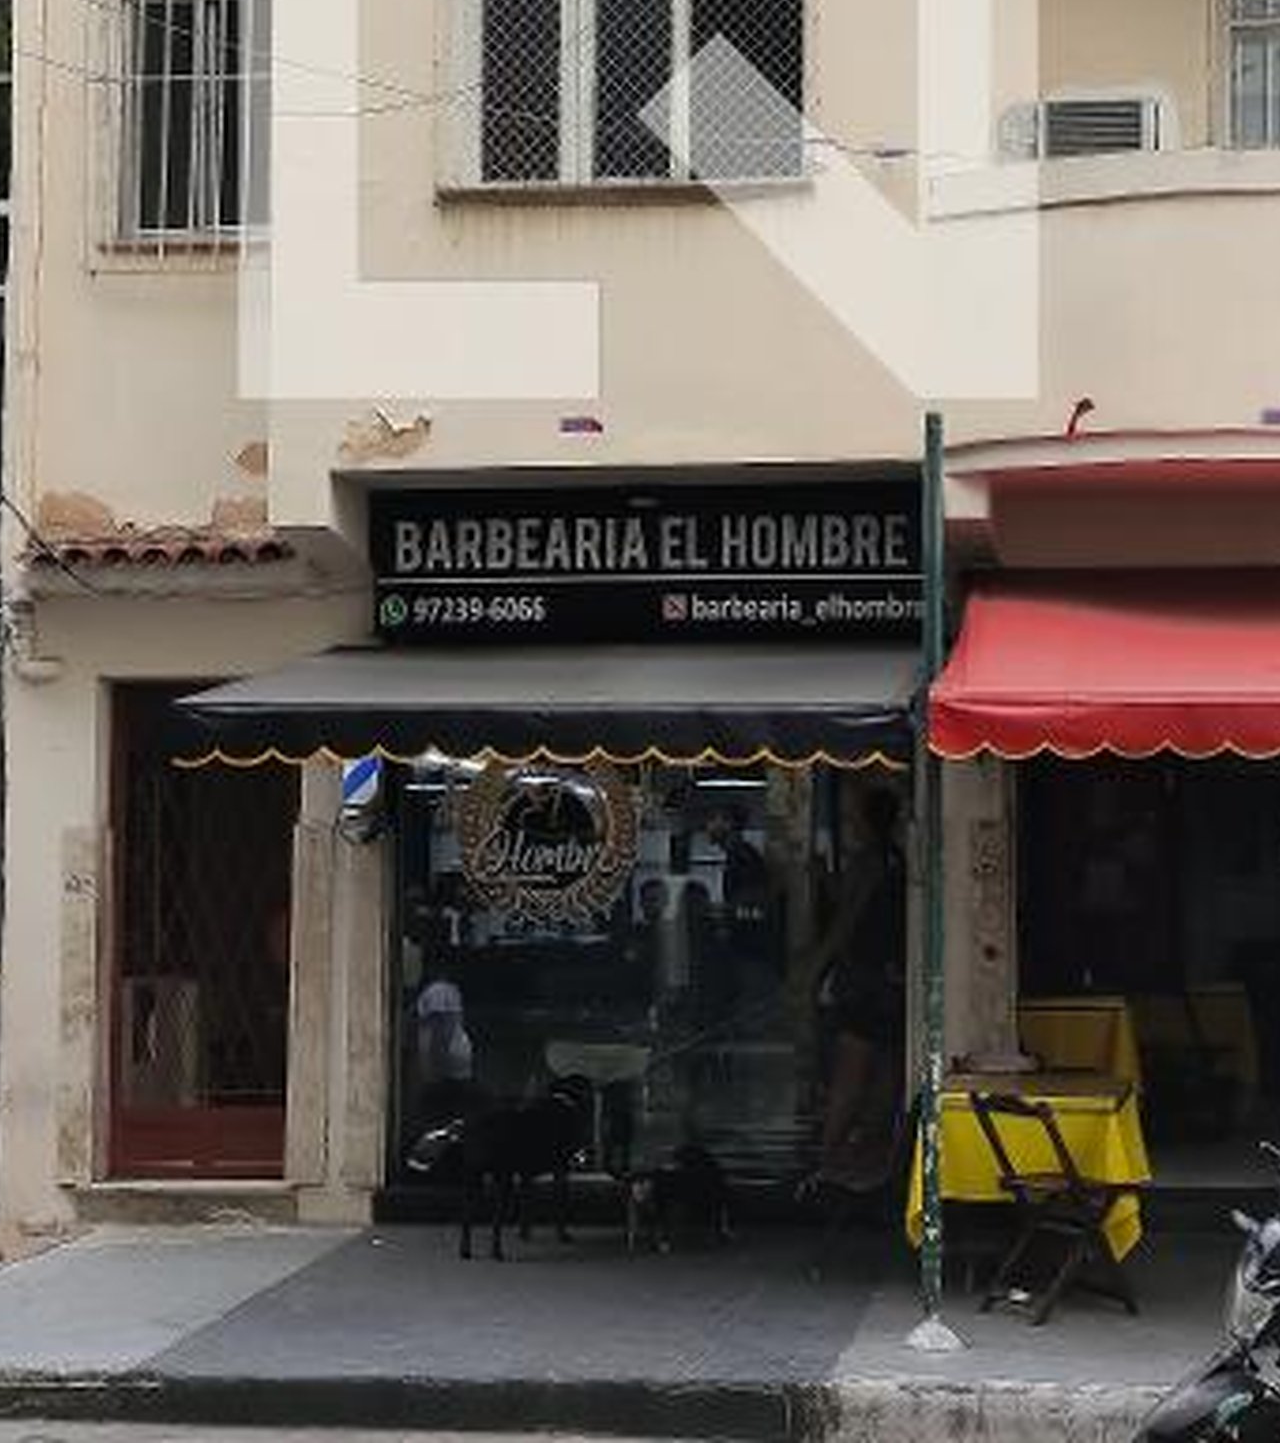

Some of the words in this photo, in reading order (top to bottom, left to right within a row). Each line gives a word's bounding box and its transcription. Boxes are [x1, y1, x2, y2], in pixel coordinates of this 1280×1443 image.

[394, 518, 650, 572] BARBEARIA
[659, 517, 709, 570] EL
[720, 513, 910, 569] HOMBRE
